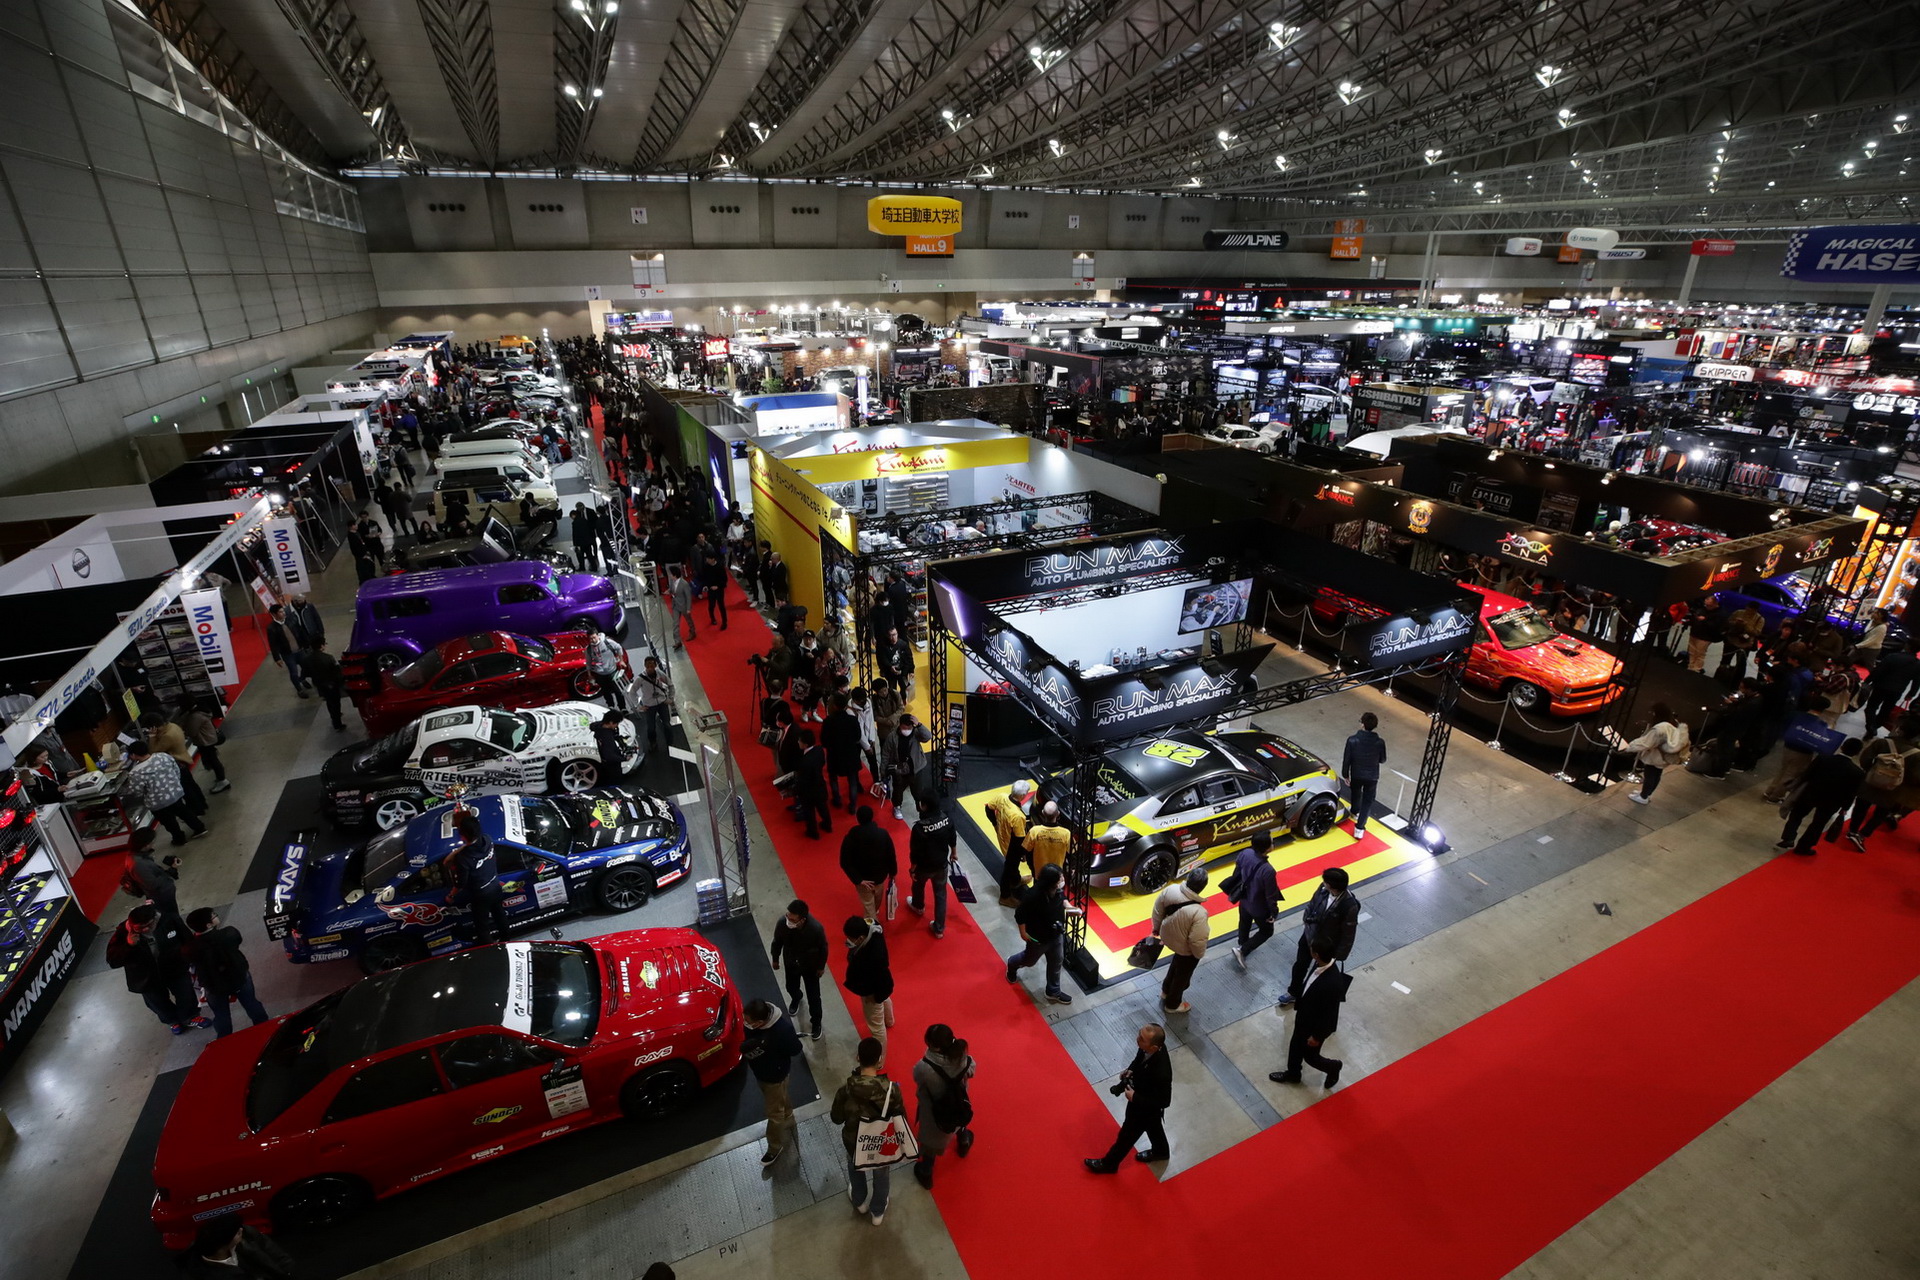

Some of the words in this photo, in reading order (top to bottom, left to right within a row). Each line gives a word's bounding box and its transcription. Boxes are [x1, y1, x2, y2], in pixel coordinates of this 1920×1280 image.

[882, 207, 960, 224] 埼玉自動車大学校
[914, 244, 937, 252] HALL
[938, 240, 947, 252] 9
[1241, 235, 1281, 246] ALPINE
[1825, 238, 1916, 250] MAGICAL
[1334, 249, 1350, 257] HALL
[1349, 247, 1358, 257] 10
[1816, 253, 1920, 271] HASE
[640, 289, 647, 297] 9
[622, 343, 652, 360] NGK
[705, 339, 727, 355] NGK
[1700, 367, 1747, 380] SKIPPER
[1363, 389, 1413, 405] SHIBATA
[273, 529, 296, 569] Mobil
[1025, 547, 1100, 577] RUN
[1106, 535, 1186, 567] MAX
[1502, 543, 1548, 563] DNA
[1031, 575, 1062, 587] AUTO
[1063, 566, 1117, 582] PLUMBING
[1117, 555, 1180, 573] SPECIALISTS
[127, 618, 145, 638] BN
[145, 596, 168, 622] Sports
[193, 605, 222, 655] Mobil
[1370, 624, 1420, 650] RUN
[1422, 612, 1476, 637] MAX
[982, 622, 1022, 670] RUN
[1372, 646, 1392, 658] AUTO
[1393, 639, 1427, 652] PLUMBING
[1428, 628, 1470, 643] SPECIALISTS
[37, 698, 60, 727] BN
[63, 666, 95, 707] Sports
[985, 646, 1001, 664] AUTO
[1001, 657, 1032, 688] PLUMBING
[1032, 686, 1077, 727] SPECIALISTS
[1092, 689, 1160, 719] RUN
[1166, 668, 1239, 702] MAX
[1097, 713, 1125, 727] AUTO
[1127, 701, 1174, 719] PLUMBING
[1175, 687, 1232, 707] SPECIALISTS
[1097, 763, 1135, 799] Kinokuni
[595, 799, 617, 828] SUNOCO
[1213, 808, 1277, 841] Kinokuni
[278, 845, 304, 899] RAYS
[606, 854, 636, 868] RAYS
[571, 869, 593, 879] BRIDE
[515, 960, 524, 983] TURISMO
[620, 960, 631, 993] SAILUN
[3, 929, 73, 1042] NANKANG
[1047, 1012, 1060, 1021] TV
[634, 1046, 673, 1066] RAYS
[475, 1105, 523, 1125] SUNOCO
[197, 1181, 262, 1203] SAILUN
[719, 1242, 738, 1259] PW
